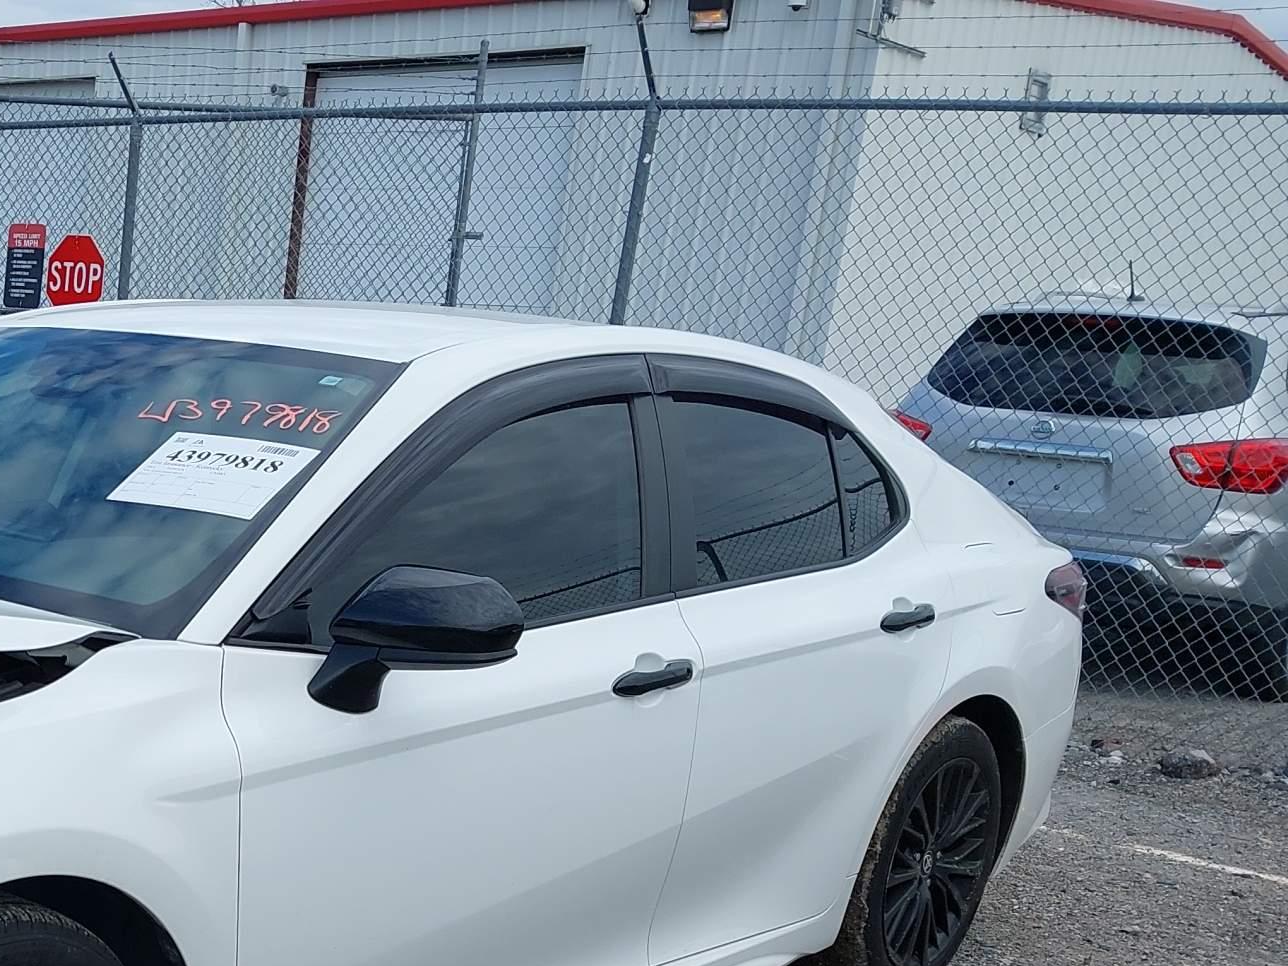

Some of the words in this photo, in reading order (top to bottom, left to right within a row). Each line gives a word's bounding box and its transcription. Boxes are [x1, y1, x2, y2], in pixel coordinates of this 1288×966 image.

[15, 239, 22, 247] 15
[23, 239, 39, 247] MPH
[49, 260, 102, 294] STOP
[166, 448, 284, 474] 43979818
